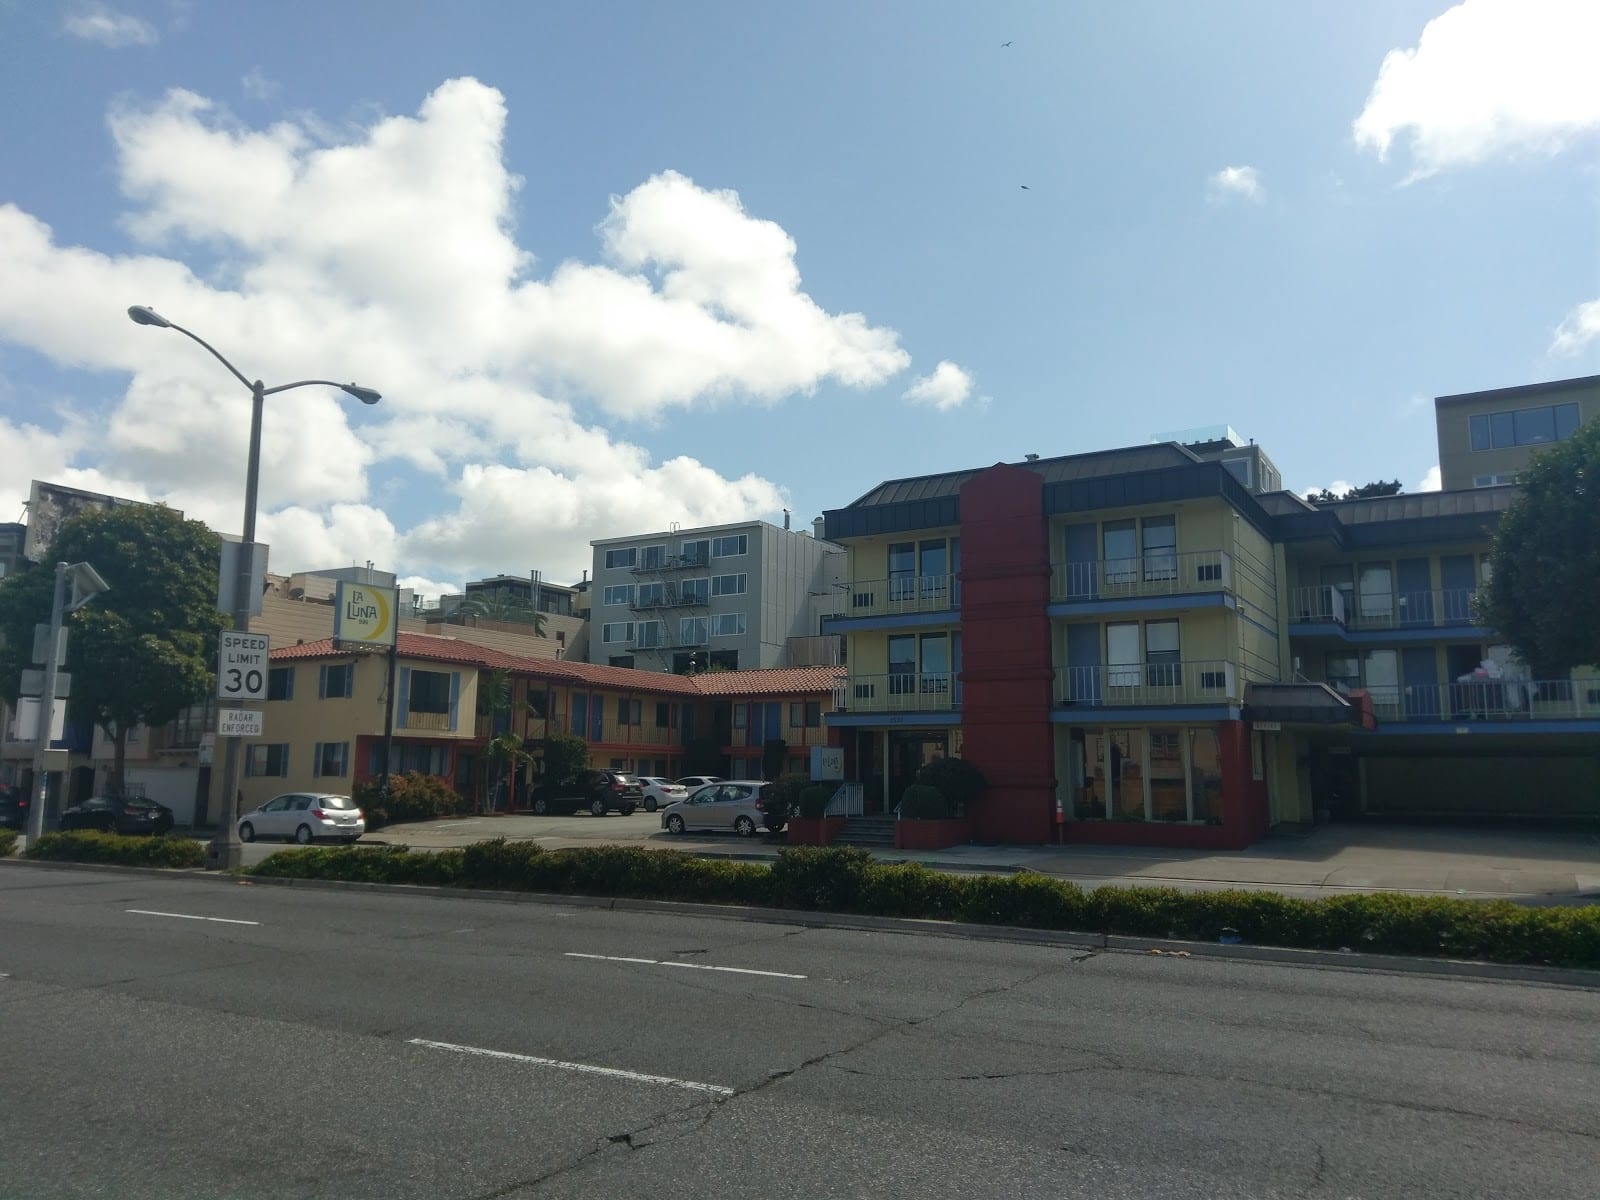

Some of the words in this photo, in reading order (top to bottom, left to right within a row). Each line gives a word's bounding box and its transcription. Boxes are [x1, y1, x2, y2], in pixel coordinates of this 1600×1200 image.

[352, 590, 363, 604] LA
[347, 601, 377, 620] LUNA
[224, 637, 266, 650] SPEED
[228, 653, 260, 665] LIMIT
[224, 668, 263, 694] 30
[228, 712, 254, 722] RADAR
[222, 723, 259, 734] ENFORCED
